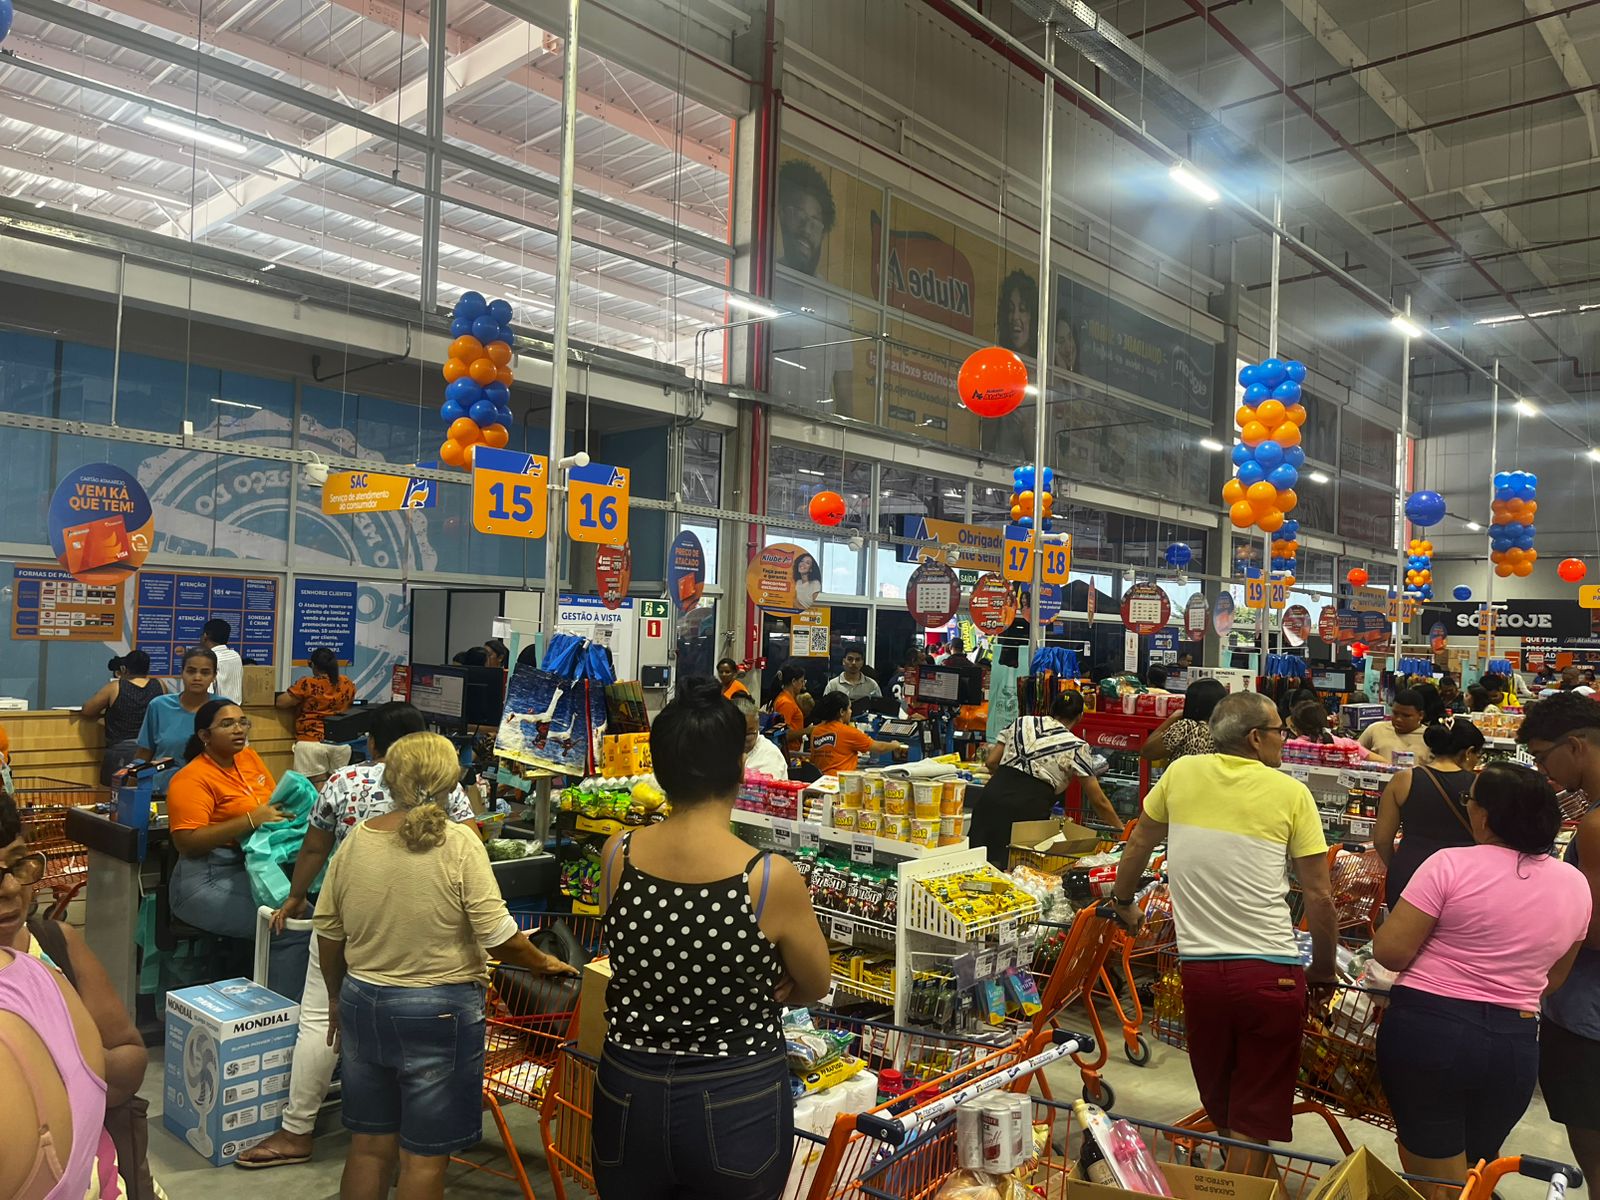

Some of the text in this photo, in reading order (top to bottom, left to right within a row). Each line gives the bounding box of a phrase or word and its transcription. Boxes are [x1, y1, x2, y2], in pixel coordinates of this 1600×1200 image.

[350, 474, 368, 489] SAC
[76, 483, 129, 500] VEM KÁ
[330, 494, 348, 503] Serviço
[356, 491, 390, 500] atendimento
[69, 496, 134, 513] QUE TEM!
[347, 500, 378, 509] consumidor
[488, 482, 534, 523] 15
[579, 493, 618, 531] 16
[116, 551, 128, 559] VISA
[762, 554, 781, 563] Klube
[1008, 546, 1029, 572] 17
[1047, 550, 1067, 576] 18
[18, 570, 47, 578] FORMAS
[959, 575, 977, 584] SAÍDA
[1249, 582, 1262, 601] 19
[1272, 585, 1284, 602] 20
[562, 611, 622, 623] GESTÃO À VISTA
[1389, 602, 1397, 617] 21
[1402, 603, 1410, 617] 22
[1496, 613, 1552, 629] HOJE
[167, 998, 192, 1020] MONDIAL
[233, 1012, 290, 1034] MONDIAL
